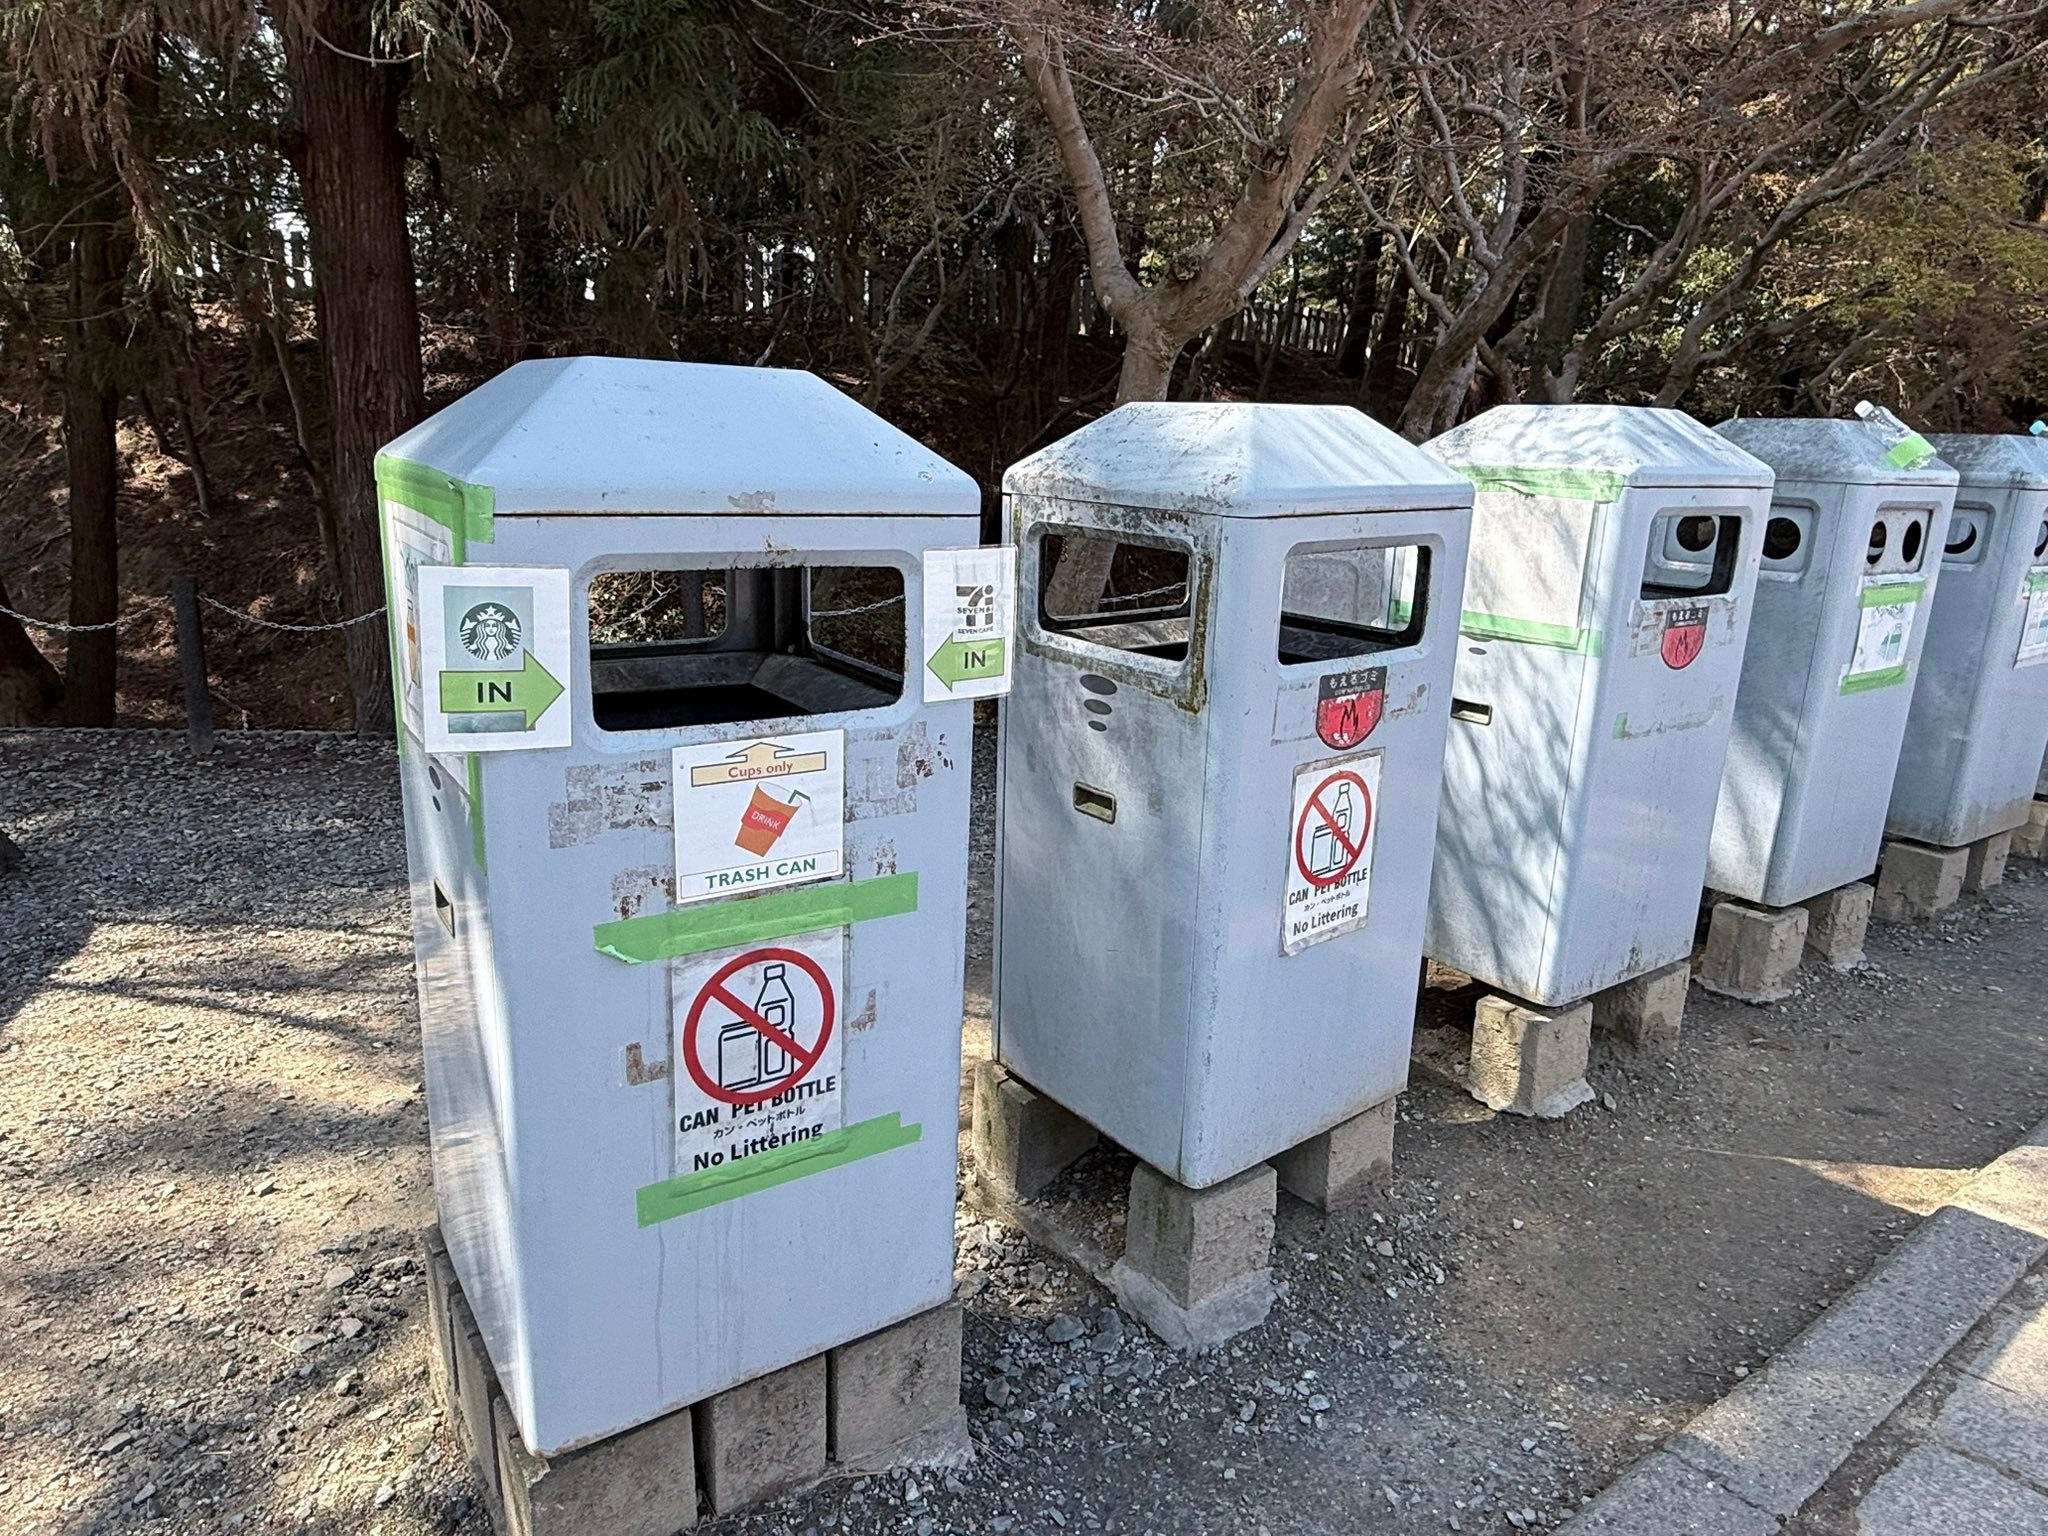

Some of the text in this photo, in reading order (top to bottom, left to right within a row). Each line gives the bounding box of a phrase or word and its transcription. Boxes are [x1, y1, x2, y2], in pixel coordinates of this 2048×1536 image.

[964, 649, 986, 669] IN
[1329, 670, 1378, 689] もえるゴミ
[477, 681, 512, 703] IN
[727, 760, 793, 780] Cups only
[751, 810, 780, 830] DRINK
[705, 858, 816, 889] TRASH CAN
[1289, 887, 1309, 905] CAN
[1293, 903, 1359, 937] No Littering
[680, 1107, 719, 1132] CAN
[771, 1075, 836, 1107] BOTTLE
[694, 1123, 824, 1171] No Littering
